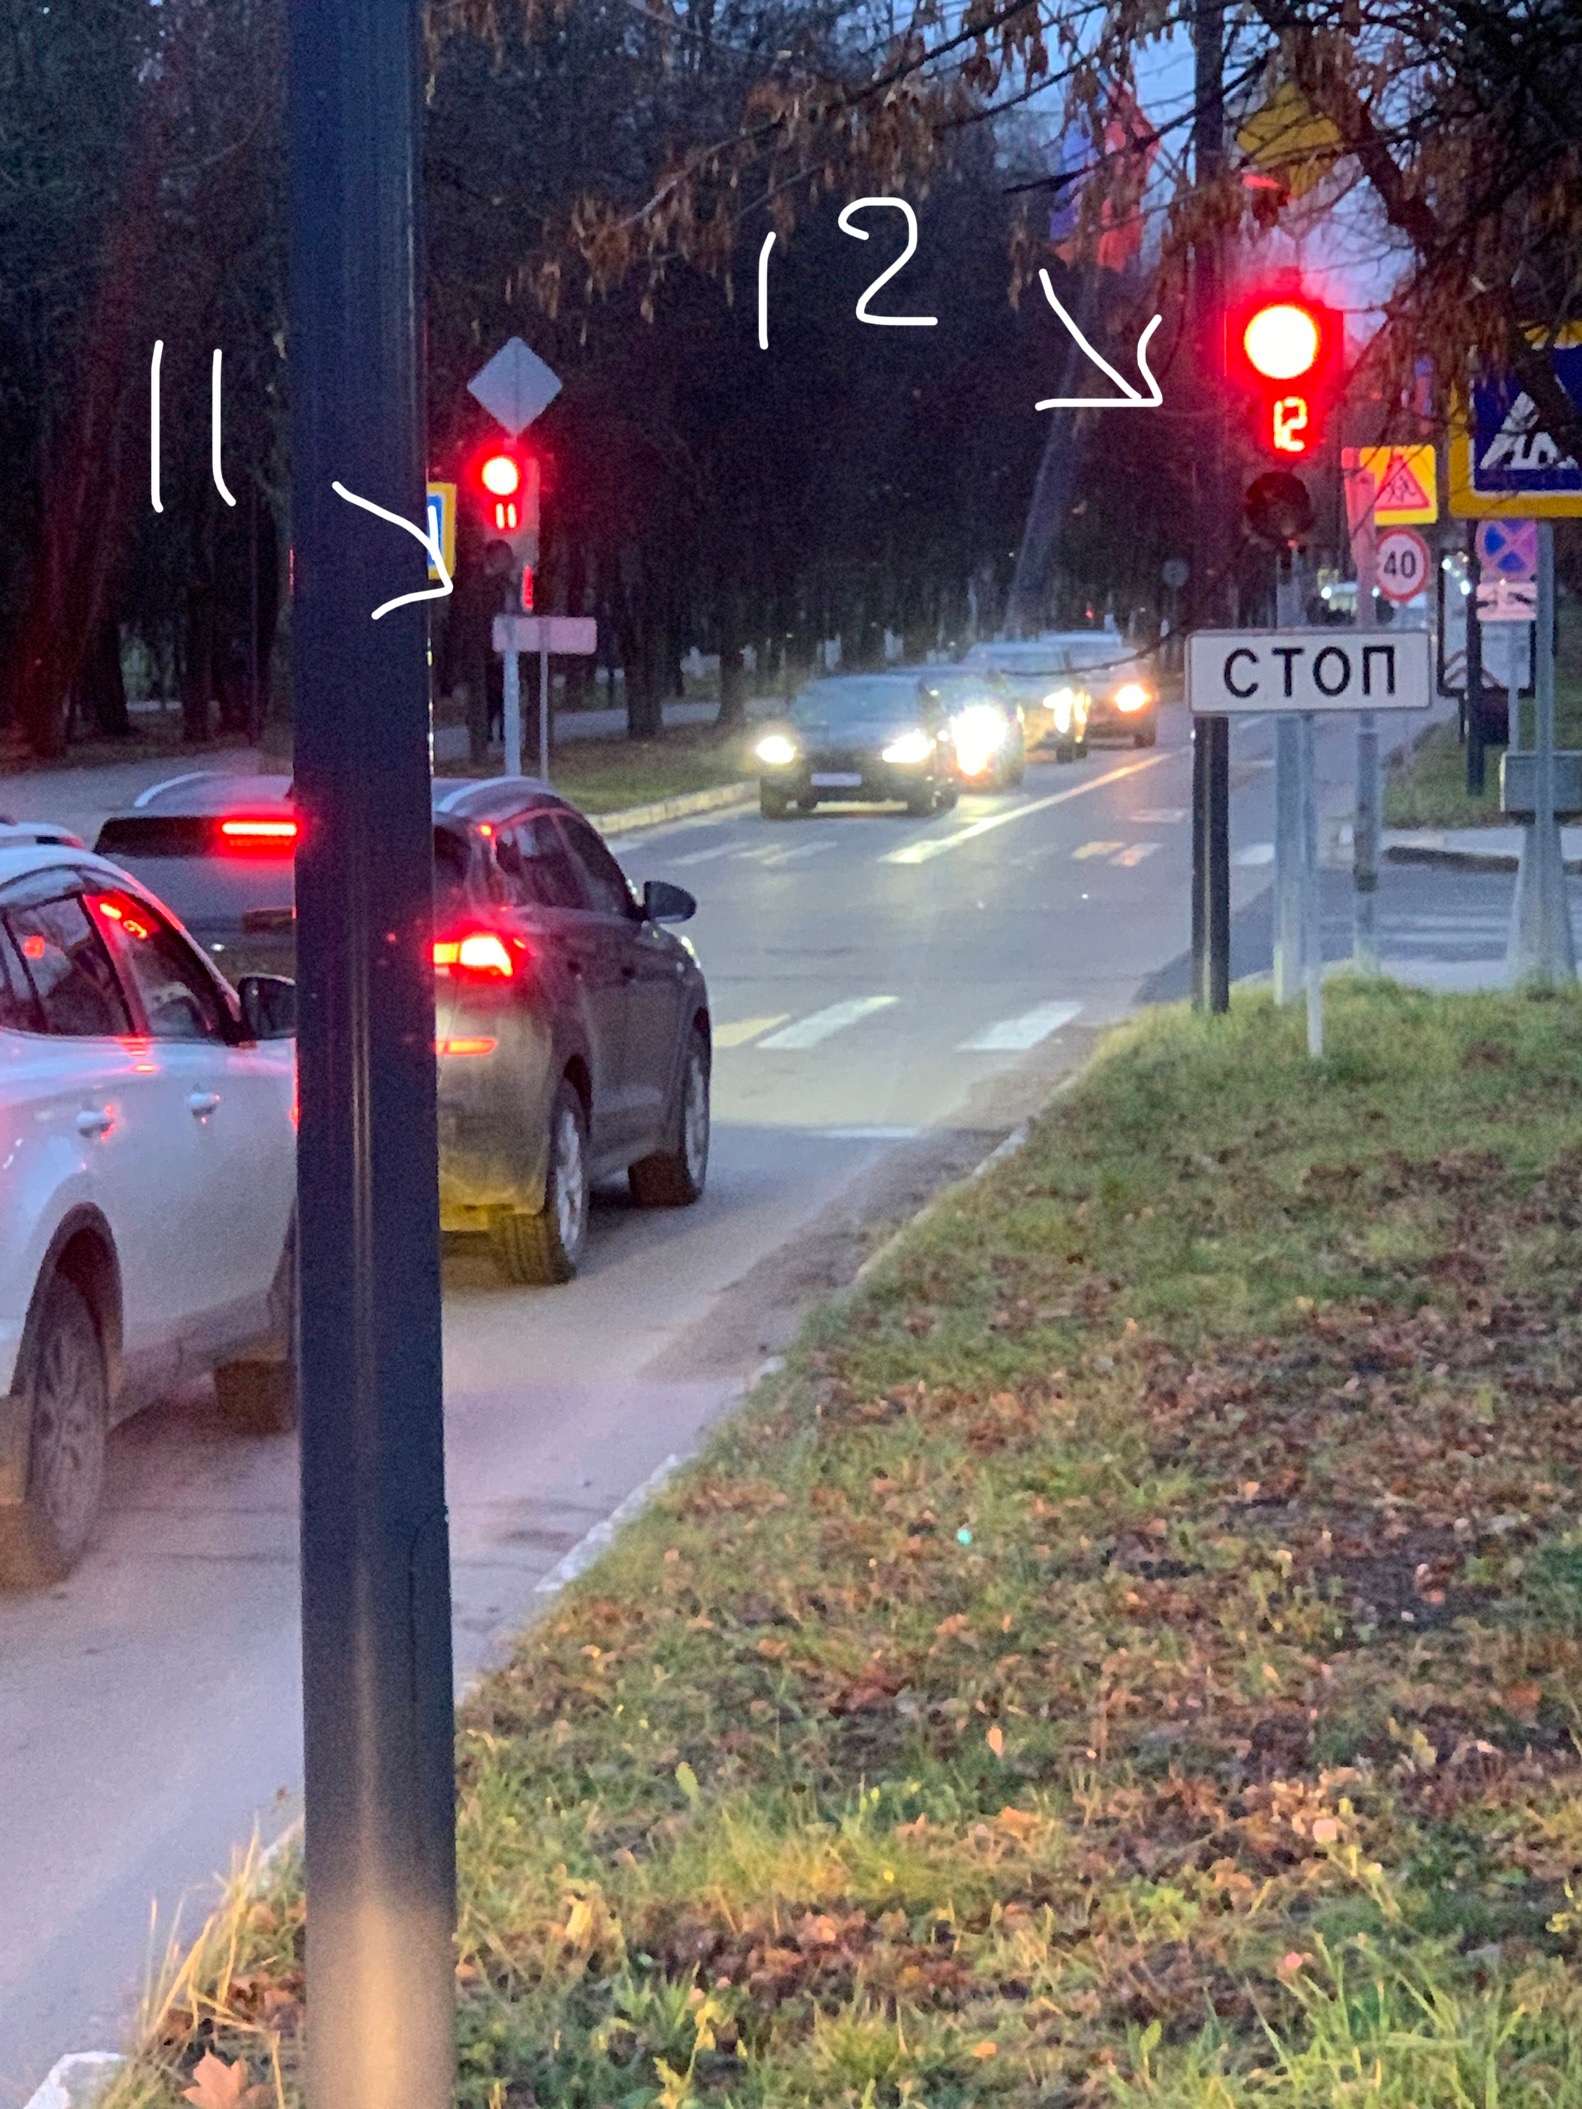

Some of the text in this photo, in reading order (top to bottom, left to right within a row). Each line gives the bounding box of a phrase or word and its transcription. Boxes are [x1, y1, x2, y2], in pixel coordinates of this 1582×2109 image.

[1273, 396, 1308, 452] 12
[495, 502, 517, 529] 11
[1384, 549, 1417, 580] 40
[1223, 645, 1397, 698] СТОП
